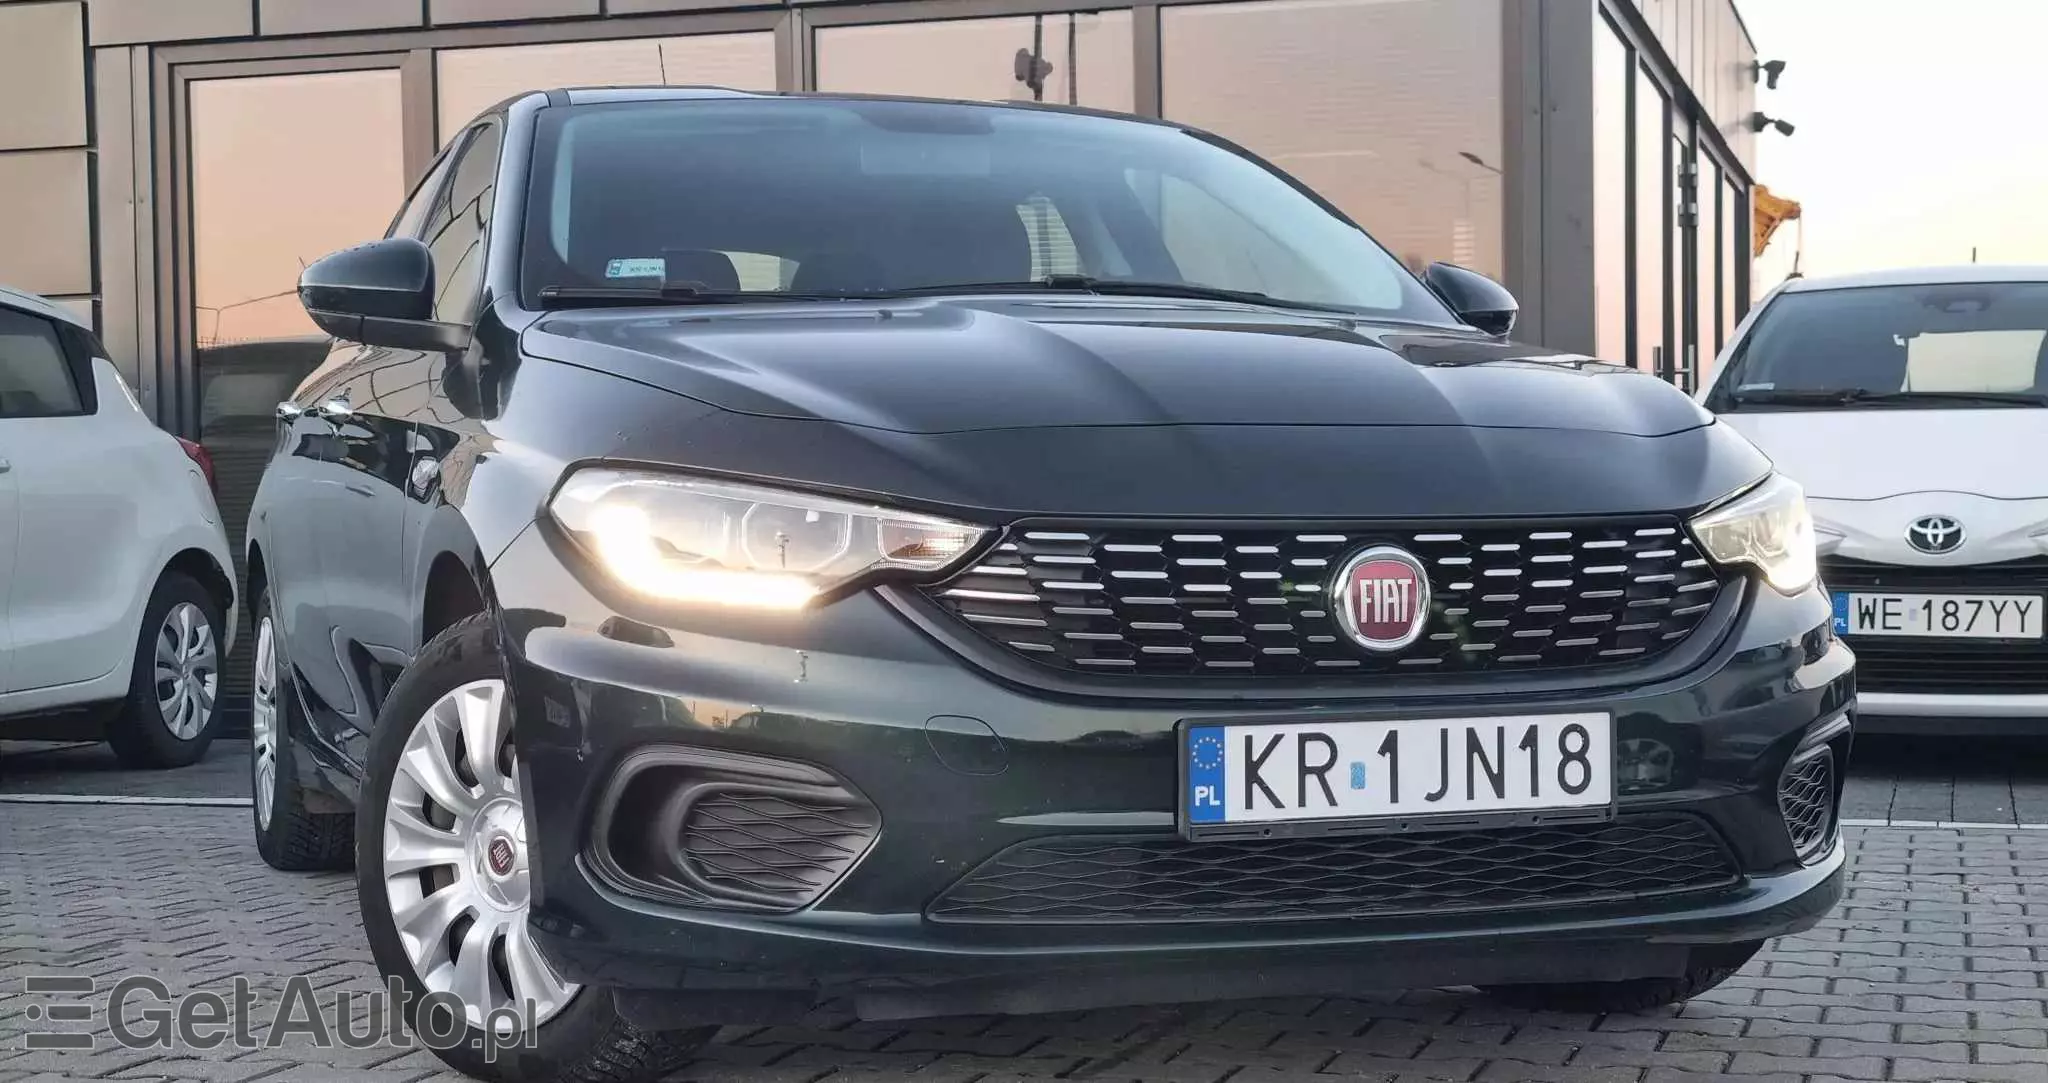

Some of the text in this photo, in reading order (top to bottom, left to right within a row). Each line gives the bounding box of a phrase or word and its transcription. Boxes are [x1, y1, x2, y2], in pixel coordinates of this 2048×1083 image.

[1360, 578, 1412, 623] FIAT
[1857, 597, 2033, 633] WE 187YY
[1834, 617, 1847, 627] PL
[1244, 723, 1592, 810] KR 1JN18
[1194, 786, 1220, 806] PL
